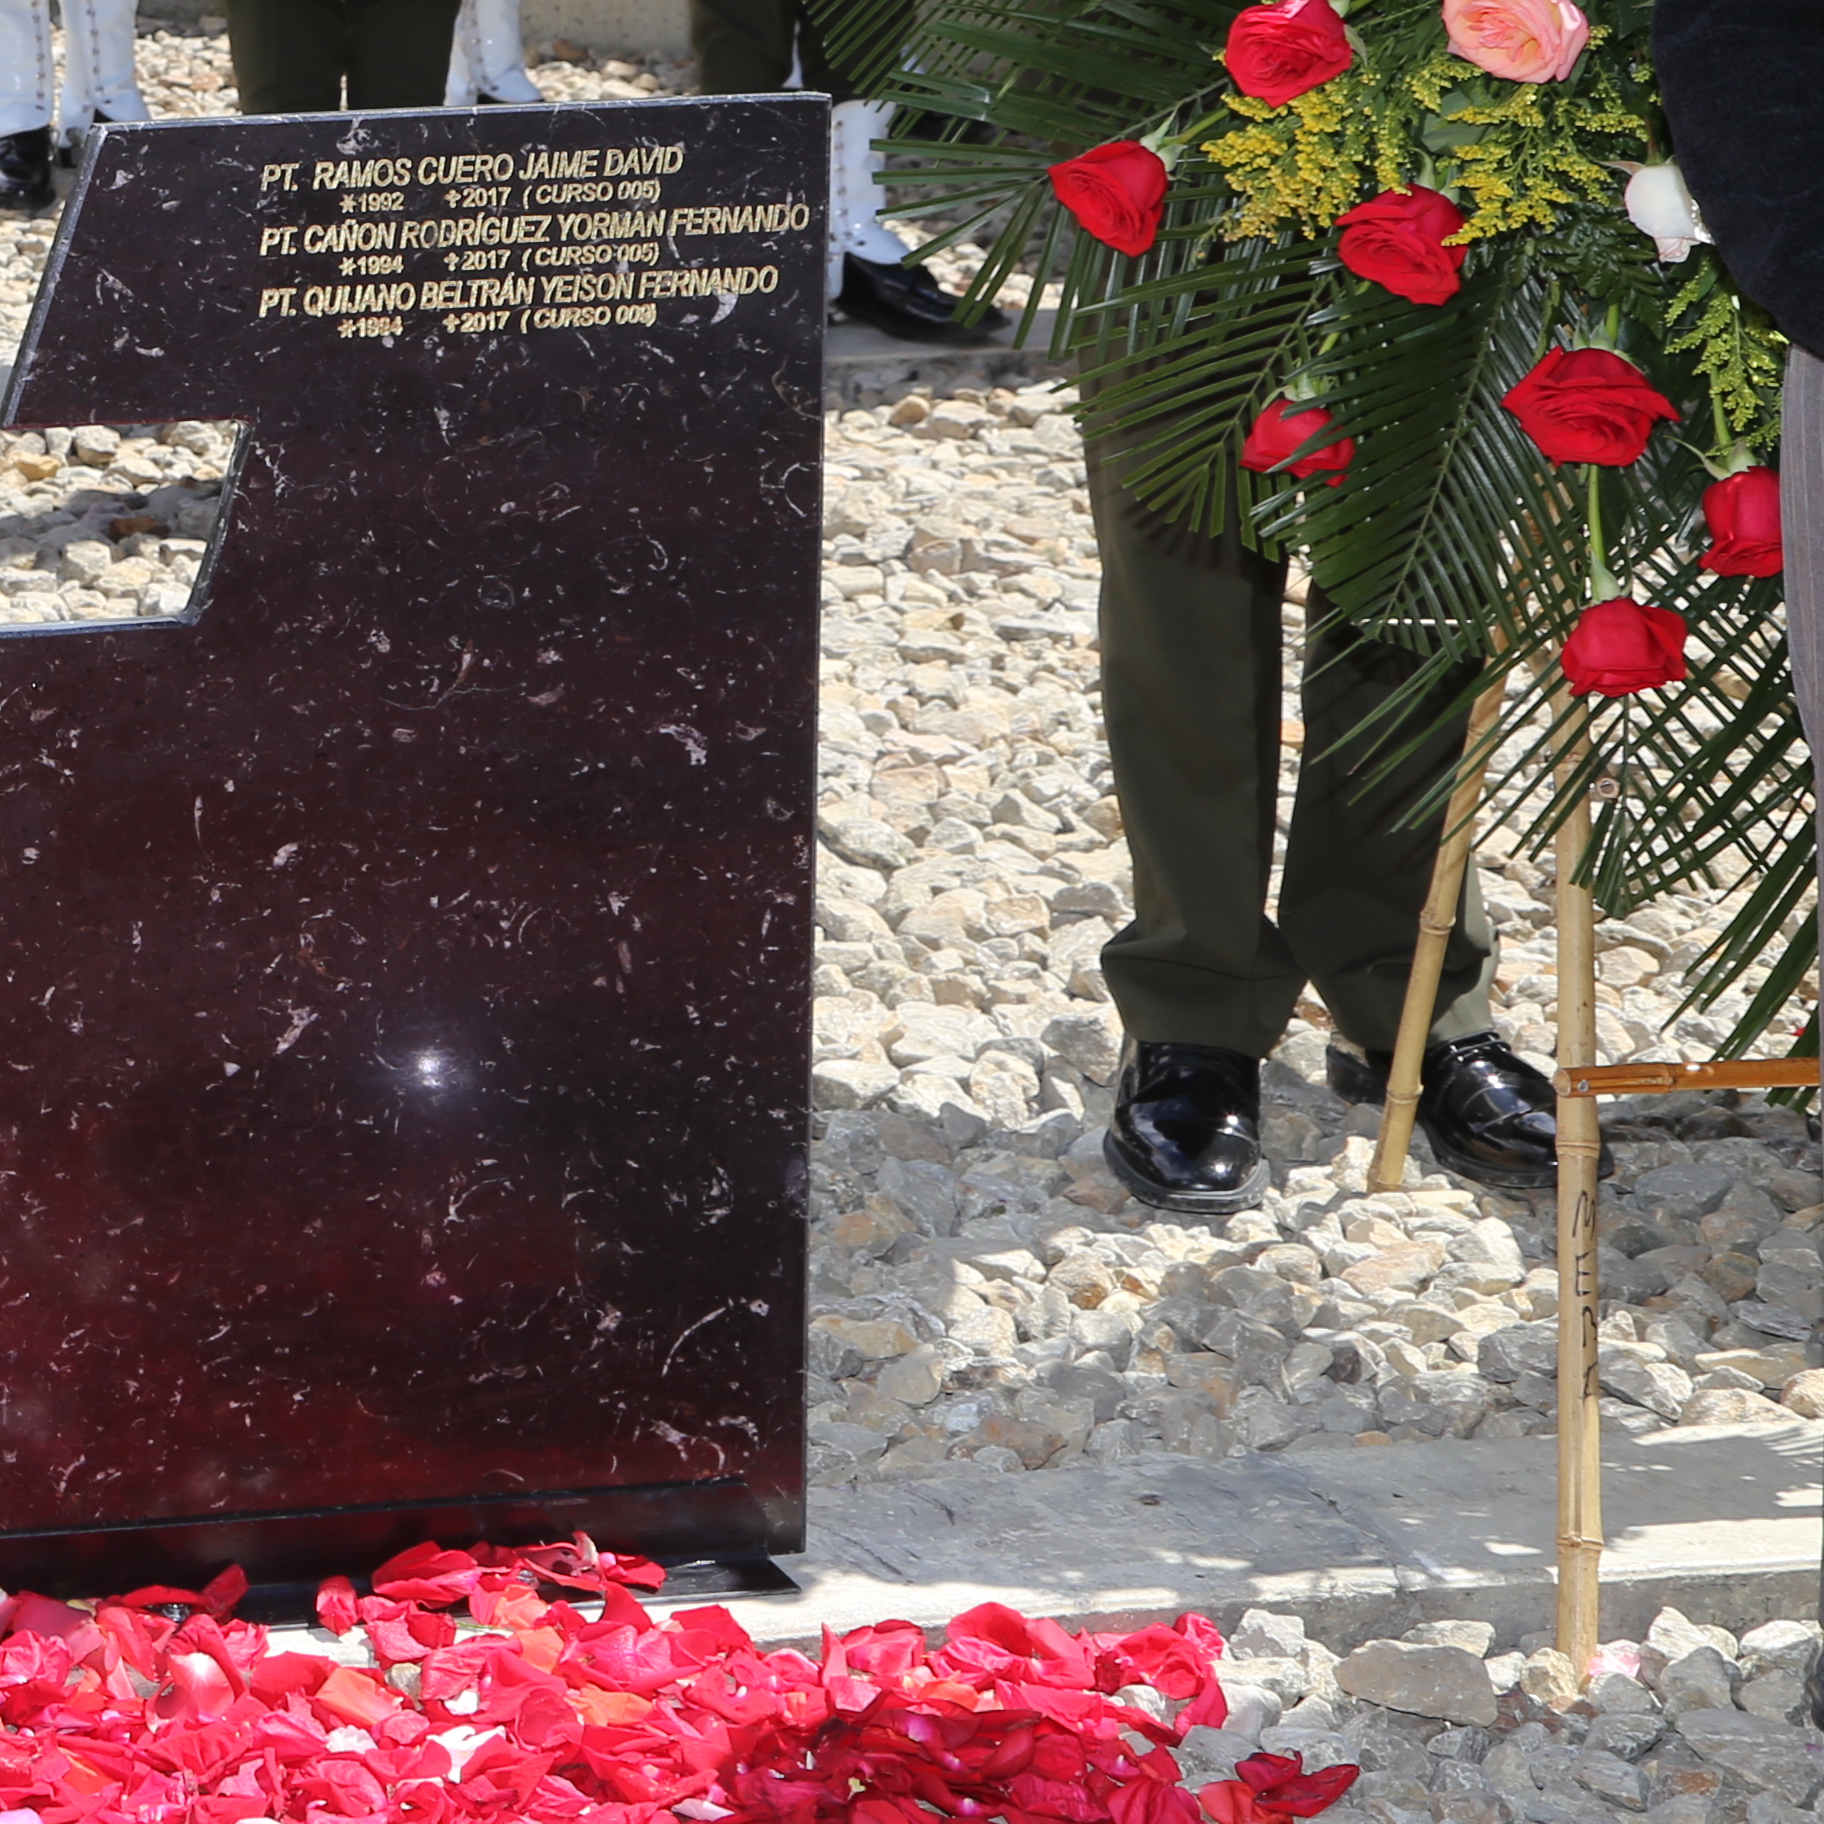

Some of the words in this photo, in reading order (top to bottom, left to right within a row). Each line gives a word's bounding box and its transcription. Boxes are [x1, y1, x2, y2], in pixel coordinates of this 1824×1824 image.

[260, 162, 302, 193] PT.
[313, 157, 411, 191] RAMOS
[417, 152, 513, 186] CUERO
[517, 148, 599, 181] JAIME
[605, 144, 683, 177] DAVID
[259, 225, 298, 257] PT.
[303, 217, 396, 255] CAÑON
[401, 209, 550, 250] RODRÍGUEZ
[557, 208, 666, 242] YORMAN
[669, 201, 809, 237] FERNANDO
[258, 288, 297, 319] PT.
[303, 282, 415, 316] QUIJANO
[420, 270, 535, 310] BELTRÁN
[540, 271, 633, 304] YEISON
[637, 264, 778, 300] FERNANDO
